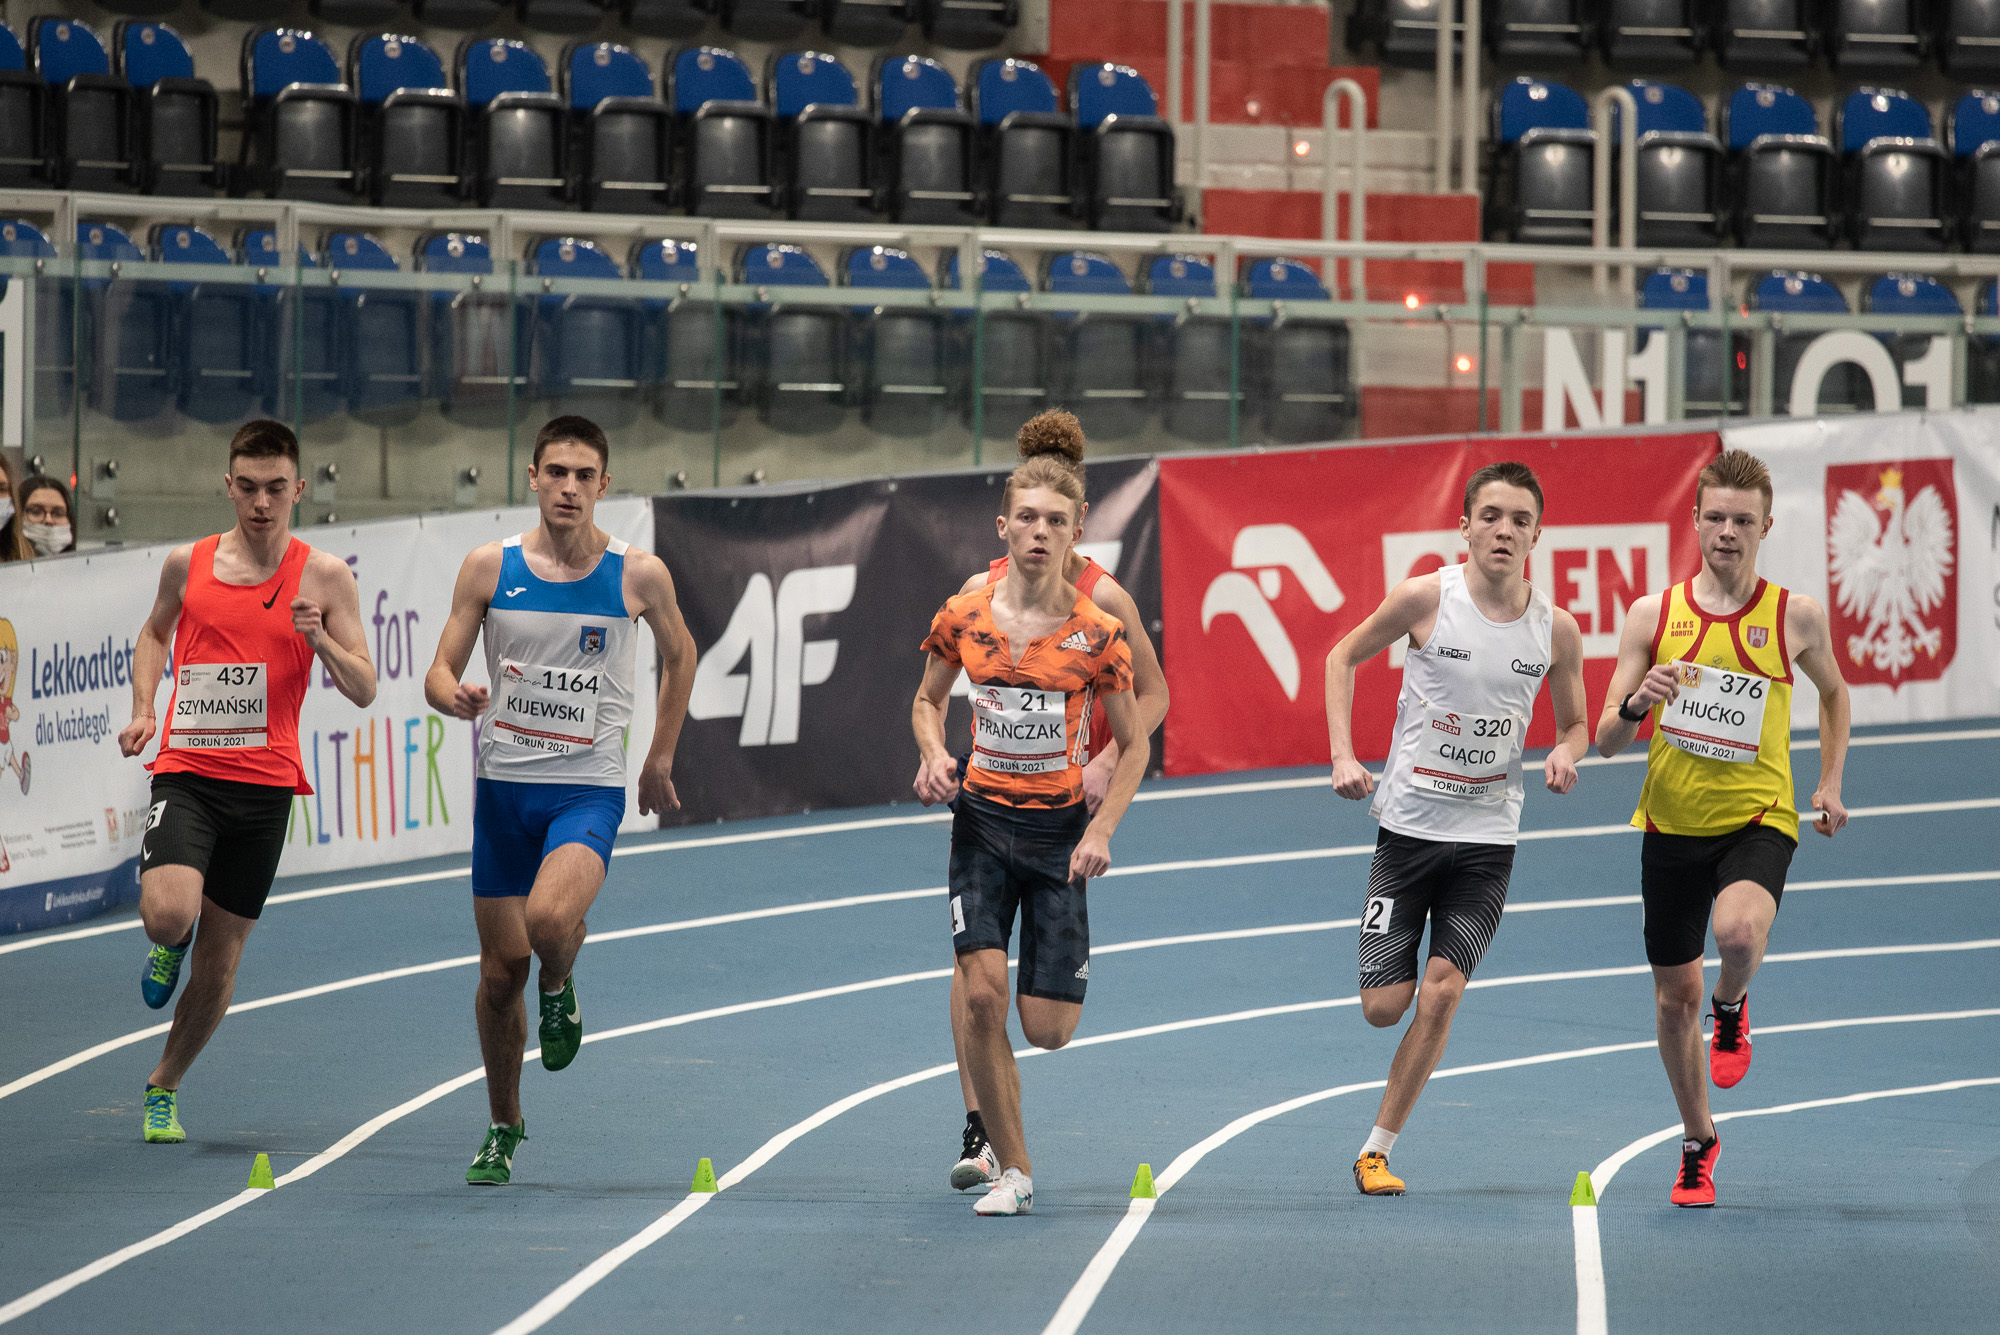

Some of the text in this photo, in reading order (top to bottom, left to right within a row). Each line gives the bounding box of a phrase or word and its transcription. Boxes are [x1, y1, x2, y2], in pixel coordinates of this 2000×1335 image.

[1543, 327, 1668, 432] N1
[372, 589, 419, 682] for
[1670, 629, 1694, 638] BORUTA
[1671, 620, 1694, 629] LAKS
[688, 564, 857, 747] 4F
[1061, 641, 1091, 653] adidas
[32, 635, 174, 699] Lekkoatleta
[217, 666, 258, 686] 437
[543, 670, 599, 694] 1164
[1719, 673, 1763, 700] 376
[177, 696, 263, 715] SZYMAŃSKI
[507, 695, 585, 723] KIJEWSKI
[976, 692, 1048, 712] ORLEN 21
[1681, 699, 1745, 727] HUĆKO
[36, 704, 112, 746] dla każdego!
[979, 716, 1062, 740] FRANCZAK
[1433, 718, 1512, 738] ORLEN 320
[187, 735, 246, 747] TORUŃ 2021
[512, 734, 570, 754] TORUŃ 2021
[1677, 738, 1735, 760] TORUŃ 2021
[988, 758, 1045, 772] TORUŃ 2021
[1439, 743, 1496, 766] CIĄCIO
[286, 713, 449, 845] LTHIER
[1433, 779, 1489, 795] TORUŃ 2021
[146, 806, 158, 830] 6
[1366, 900, 1384, 930] 2
